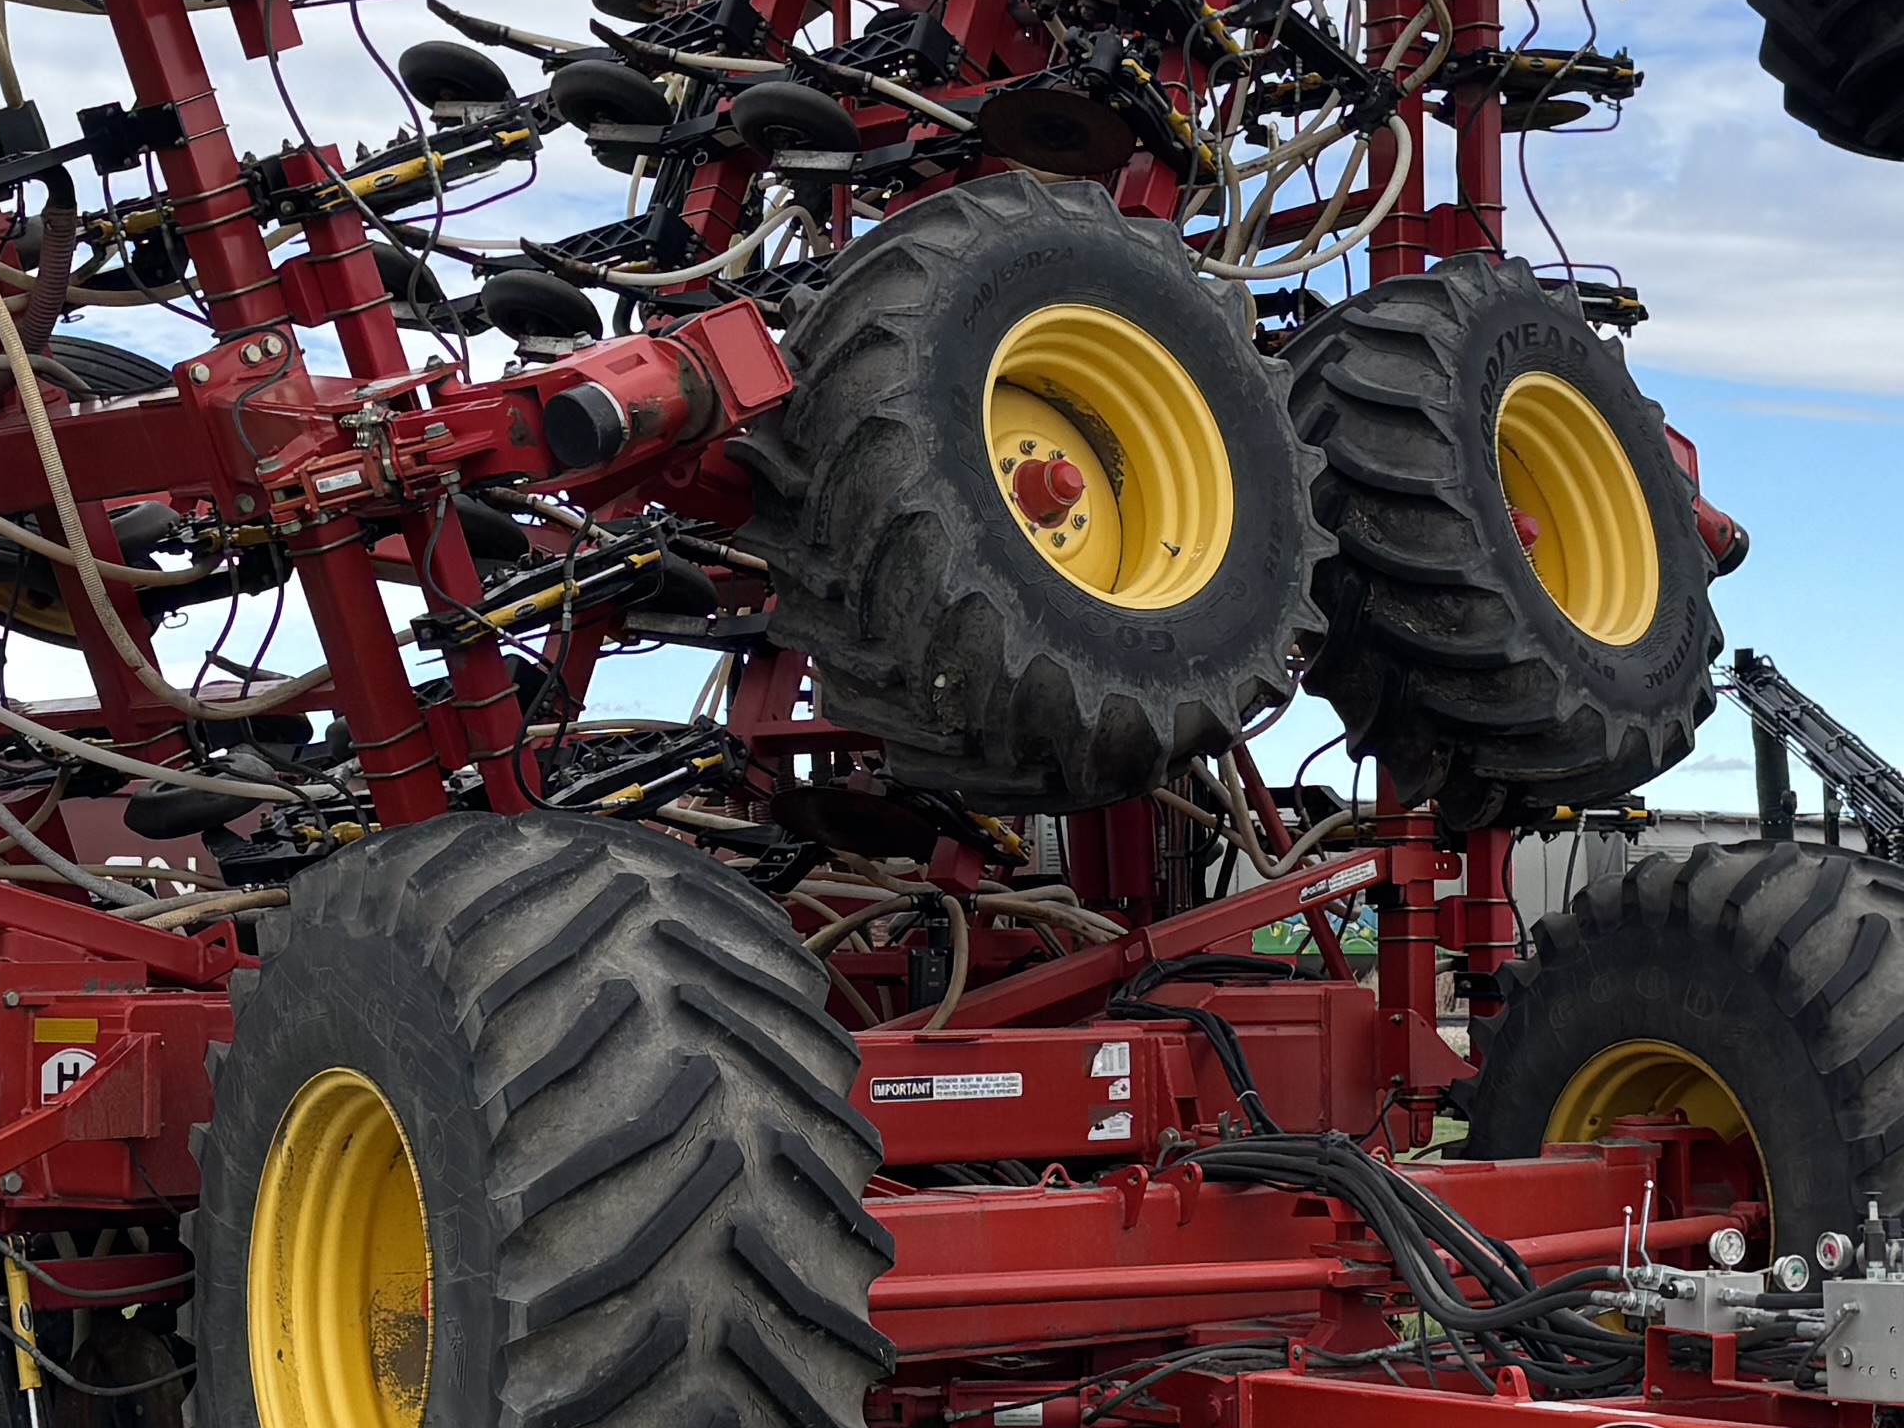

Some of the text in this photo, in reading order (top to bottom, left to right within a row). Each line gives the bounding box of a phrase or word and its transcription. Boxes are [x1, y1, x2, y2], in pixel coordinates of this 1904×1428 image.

[963, 246, 1075, 332] 540/65R24
[1480, 322, 1588, 483] GOODYEAR
[1644, 595, 1698, 690] OPTITRAC
[57, 1061, 81, 1094] H
[873, 1081, 932, 1098] IMPORTANT
